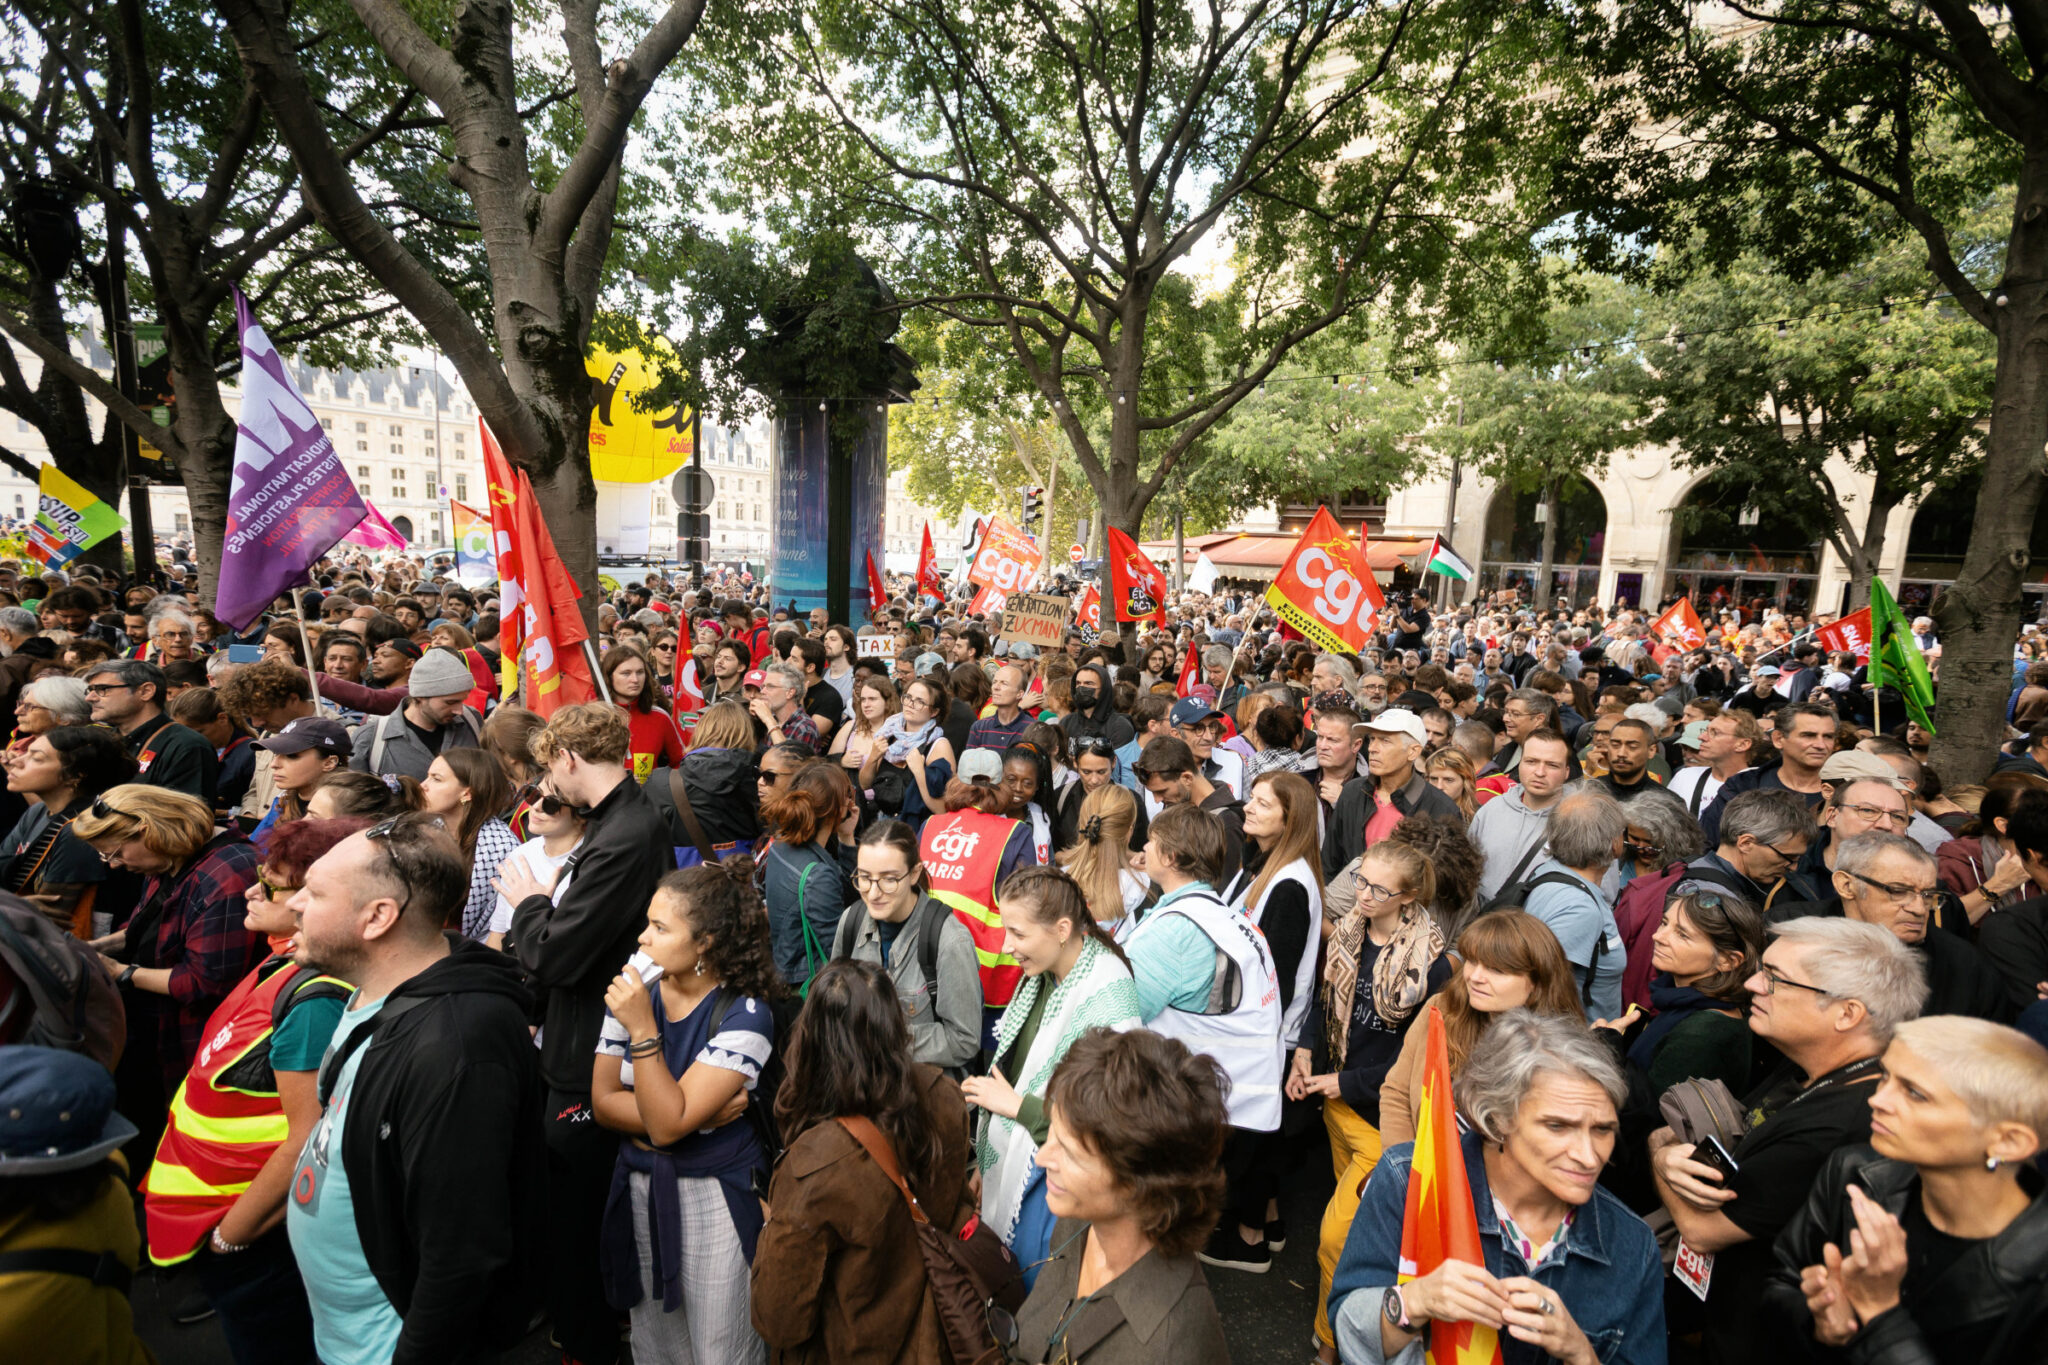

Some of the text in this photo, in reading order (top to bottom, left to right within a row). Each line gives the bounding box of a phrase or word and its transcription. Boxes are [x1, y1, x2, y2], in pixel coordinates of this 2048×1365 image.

[609, 364, 626, 386] PTT
[978, 548, 1036, 592] cgt
[1004, 615, 1061, 639] ZUCMAN
[1283, 602, 1345, 651] Finances
[860, 639, 891, 652] TAX
[930, 832, 980, 861] cgt
